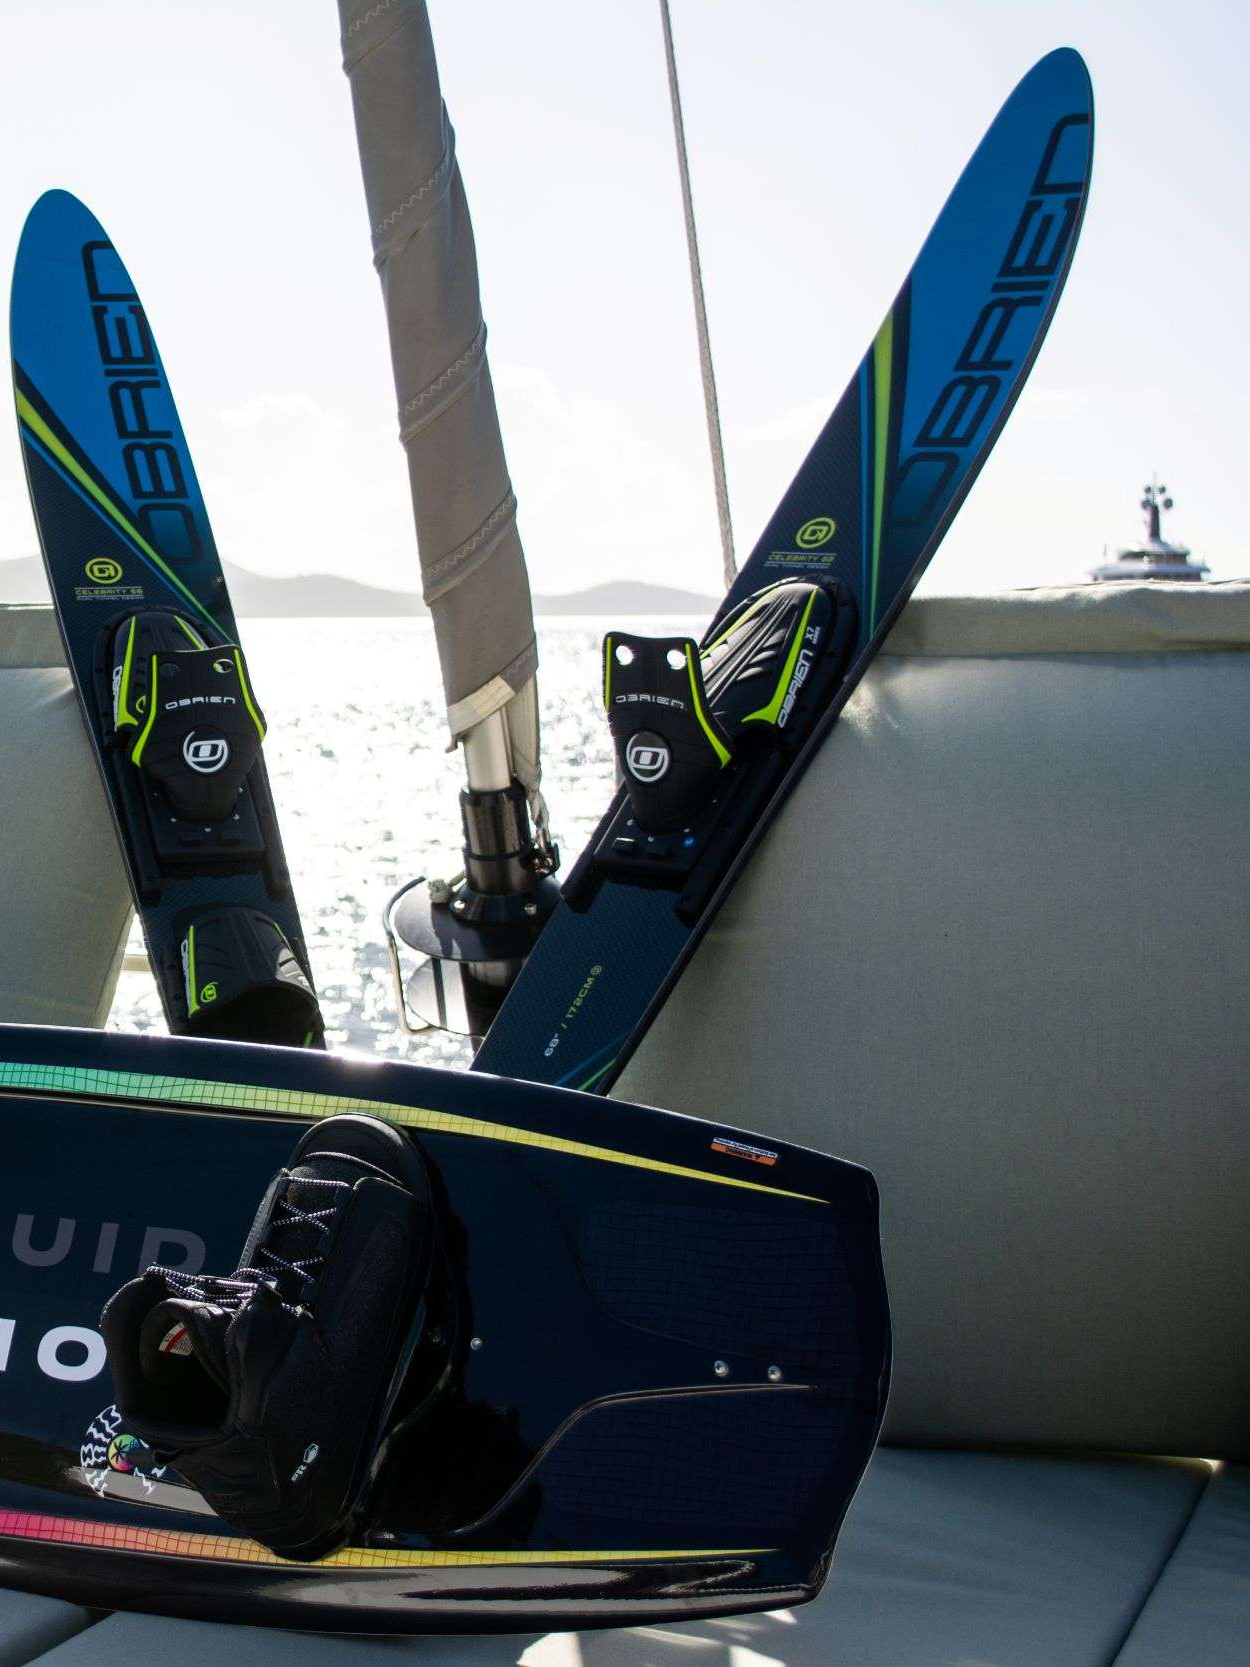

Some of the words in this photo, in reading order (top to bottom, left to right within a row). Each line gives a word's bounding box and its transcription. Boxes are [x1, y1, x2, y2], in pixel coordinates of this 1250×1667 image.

[75, 588, 127, 596] CELEBRITY
[777, 649, 814, 729] OBRIEN
[165, 696, 236, 710] OBRIEN
[615, 694, 685, 709] OBRIEN
[565, 977, 595, 1018] 172CM
